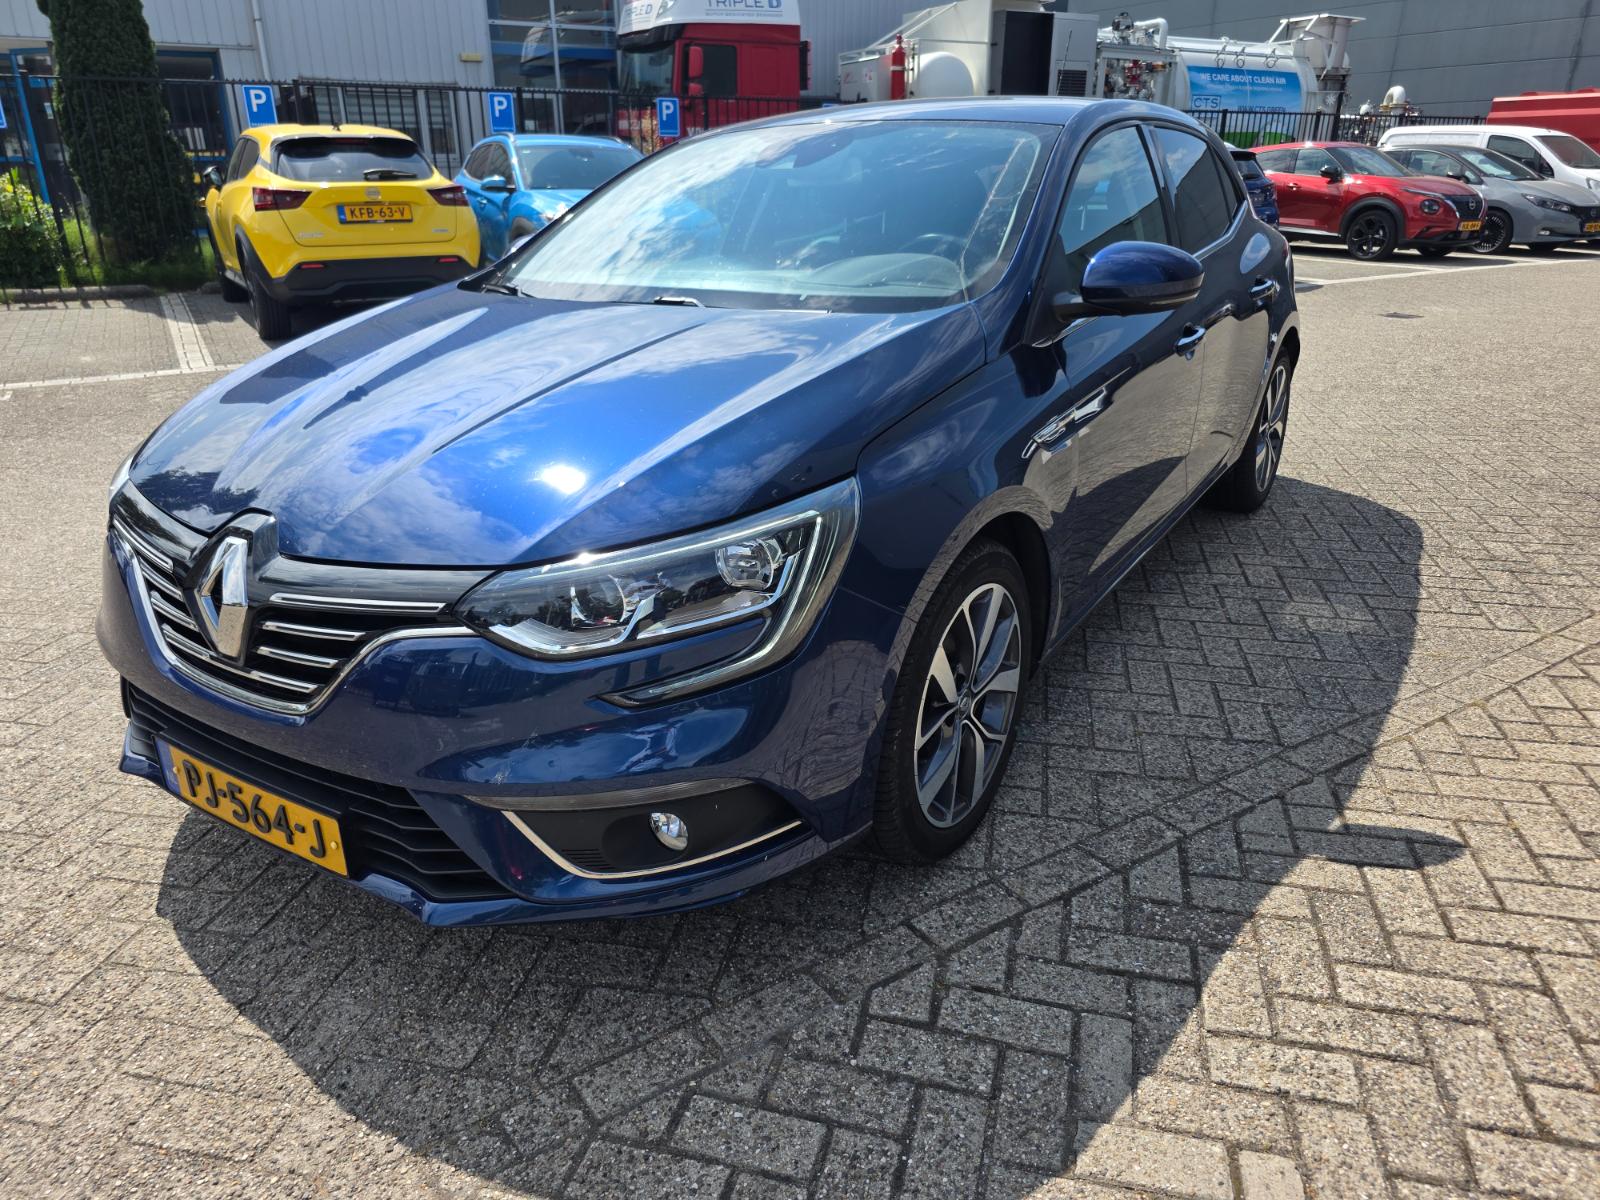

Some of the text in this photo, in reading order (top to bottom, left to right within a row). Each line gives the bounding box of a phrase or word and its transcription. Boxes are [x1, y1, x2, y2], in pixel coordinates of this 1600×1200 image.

[1212, 74, 1230, 82] CARE
[1231, 75, 1253, 83] ABOUT
[1254, 76, 1275, 84] CLEAN
[250, 89, 267, 112] P
[494, 96, 508, 117] P
[1193, 97, 1219, 109] CTS
[662, 101, 674, 121] P
[349, 207, 405, 219] KFB-63-V
[182, 758, 326, 859] PJ-564-J
